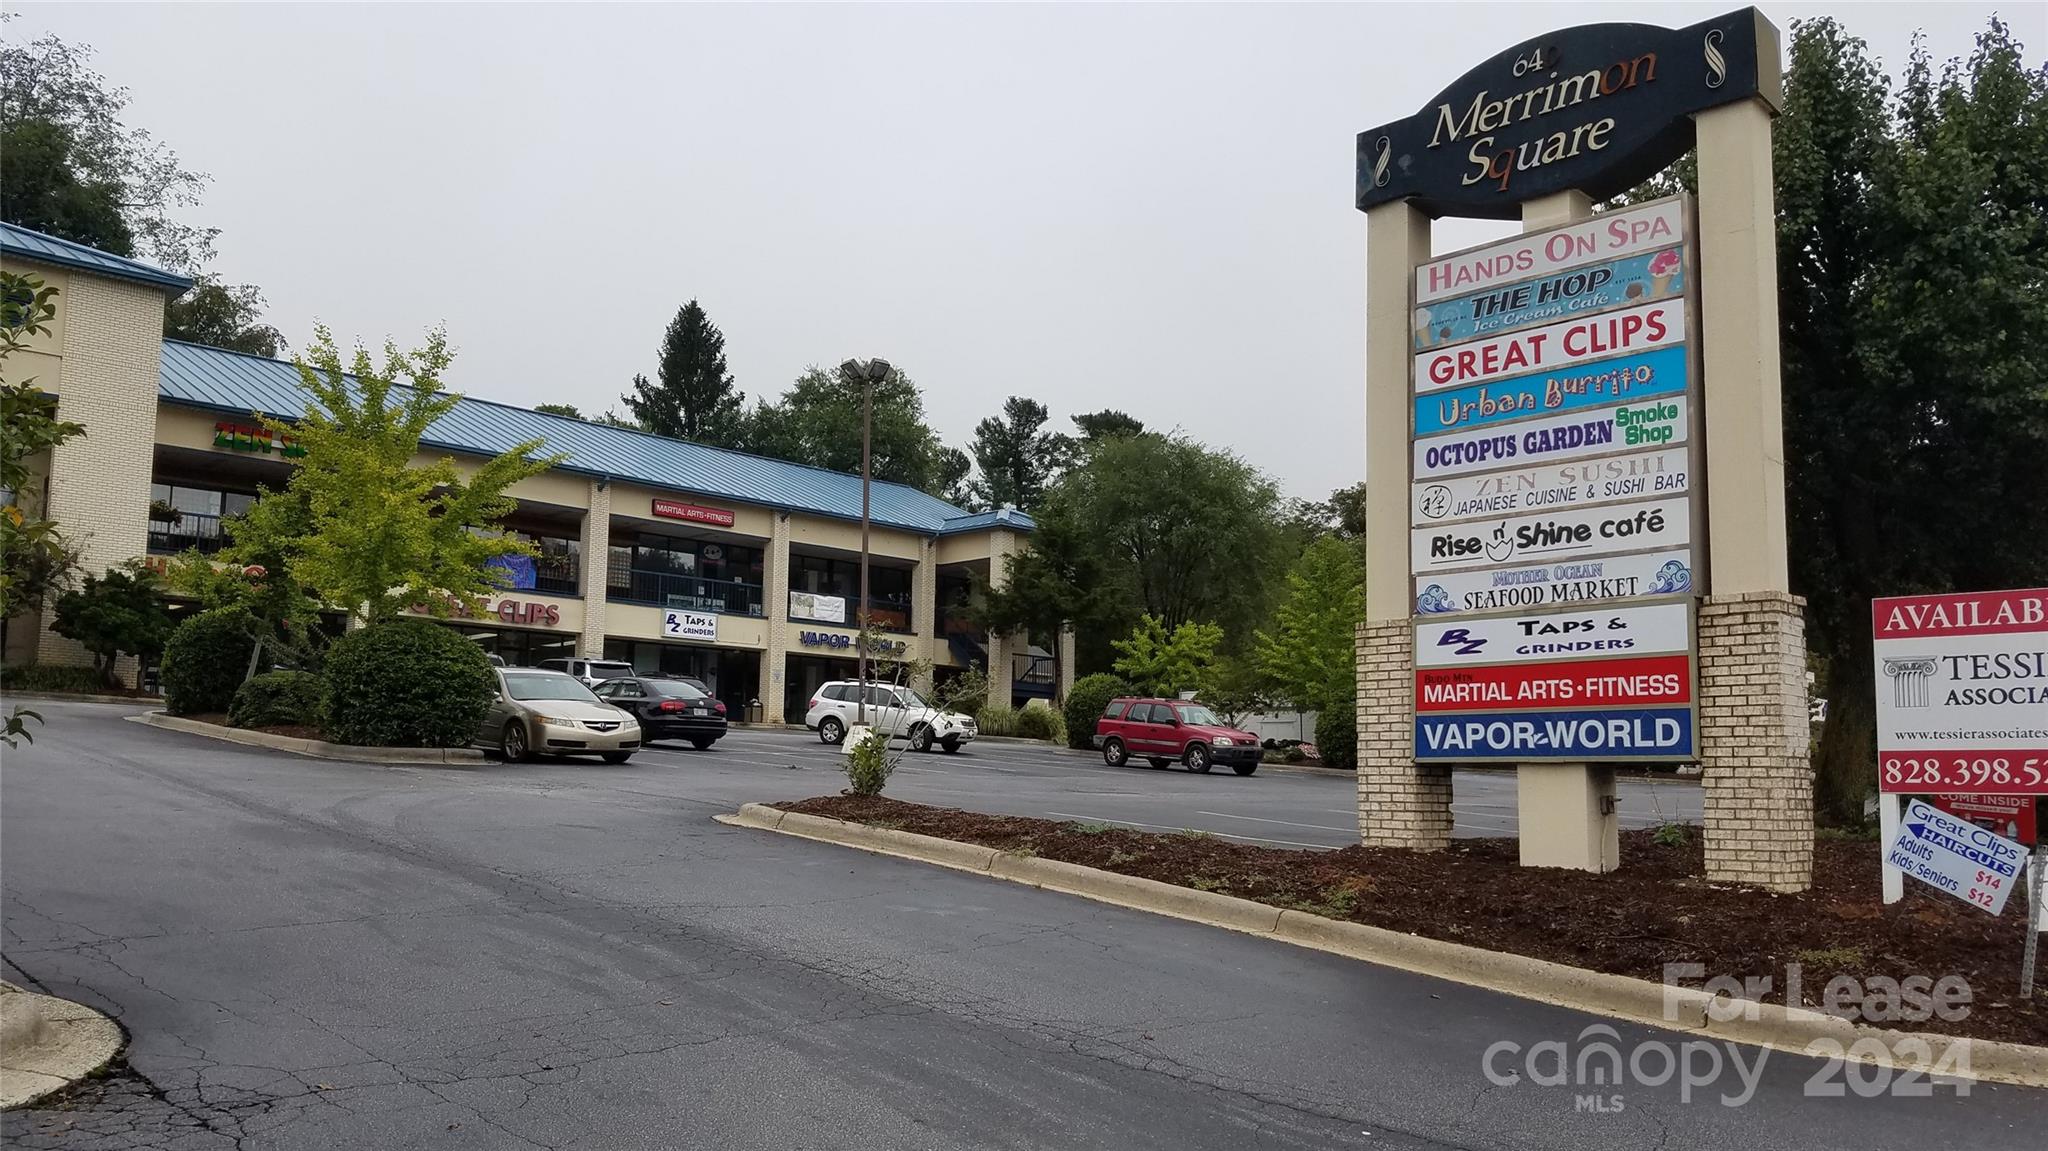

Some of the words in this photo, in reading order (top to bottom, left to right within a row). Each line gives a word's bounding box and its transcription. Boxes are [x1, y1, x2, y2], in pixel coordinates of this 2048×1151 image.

[1426, 51, 1657, 148] Merrimon
[1461, 118, 1615, 193] Square
[1430, 249, 1534, 293] HANDS
[1608, 216, 1672, 249] SPA
[1471, 284, 1531, 321] THE
[1537, 267, 1613, 305] HOP
[1473, 318, 1498, 334] Ice
[1503, 304, 1563, 325] Cream
[1429, 334, 1547, 384] GREAT
[1563, 309, 1667, 357] CLIPS
[1439, 387, 1536, 426] Urban
[1544, 364, 1655, 409] Burrito
[1615, 402, 1679, 427] Smoke
[213, 422, 273, 454] ZEN
[1426, 434, 1517, 468] OCTOPUS
[1523, 419, 1613, 454] GARDEN
[1625, 422, 1673, 445] Shop
[1475, 472, 1537, 497] ZEN
[1559, 455, 1665, 485] SUSHI
[656, 504, 685, 516] MARTIAL
[1453, 493, 1517, 516] JAPANESE
[1526, 486, 1577, 506] CUISINE
[1586, 483, 1596, 499] &
[1604, 477, 1645, 497] SUSHI
[1654, 472, 1686, 491] BAR
[1431, 534, 1483, 558] Rise
[1516, 521, 1592, 549] Shine
[1599, 508, 1665, 539] café
[1492, 566, 1549, 587] MOTHER
[1553, 562, 1604, 580] OCEAN
[1464, 584, 1543, 610] SEAFOOD
[1551, 576, 1639, 604] MARKET
[498, 599, 560, 625] CLIPS
[684, 615, 705, 626] TAPS
[1517, 619, 1595, 637] TAPS
[1608, 617, 1627, 630] &
[1884, 598, 2048, 631] AVAILAB
[683, 627, 714, 636] GRINDERS
[800, 631, 850, 649] VAPOR
[1516, 637, 1635, 656] GRINDERS
[1424, 682, 1513, 703] MARTIAL
[1424, 722, 1535, 750] VAPOR
[1544, 718, 1681, 748] WORLD
[1983, 795, 2030, 808] INSIDE
[1912, 804, 1966, 838] Great
[1971, 830, 2019, 860] Clips
[1897, 835, 1934, 861] Adults
[1975, 870, 2001, 890] $14
[1920, 828, 2014, 876] HAIRCUTS
[1889, 850, 1959, 891] Kids/Seniors
[1967, 887, 1994, 907] $12
